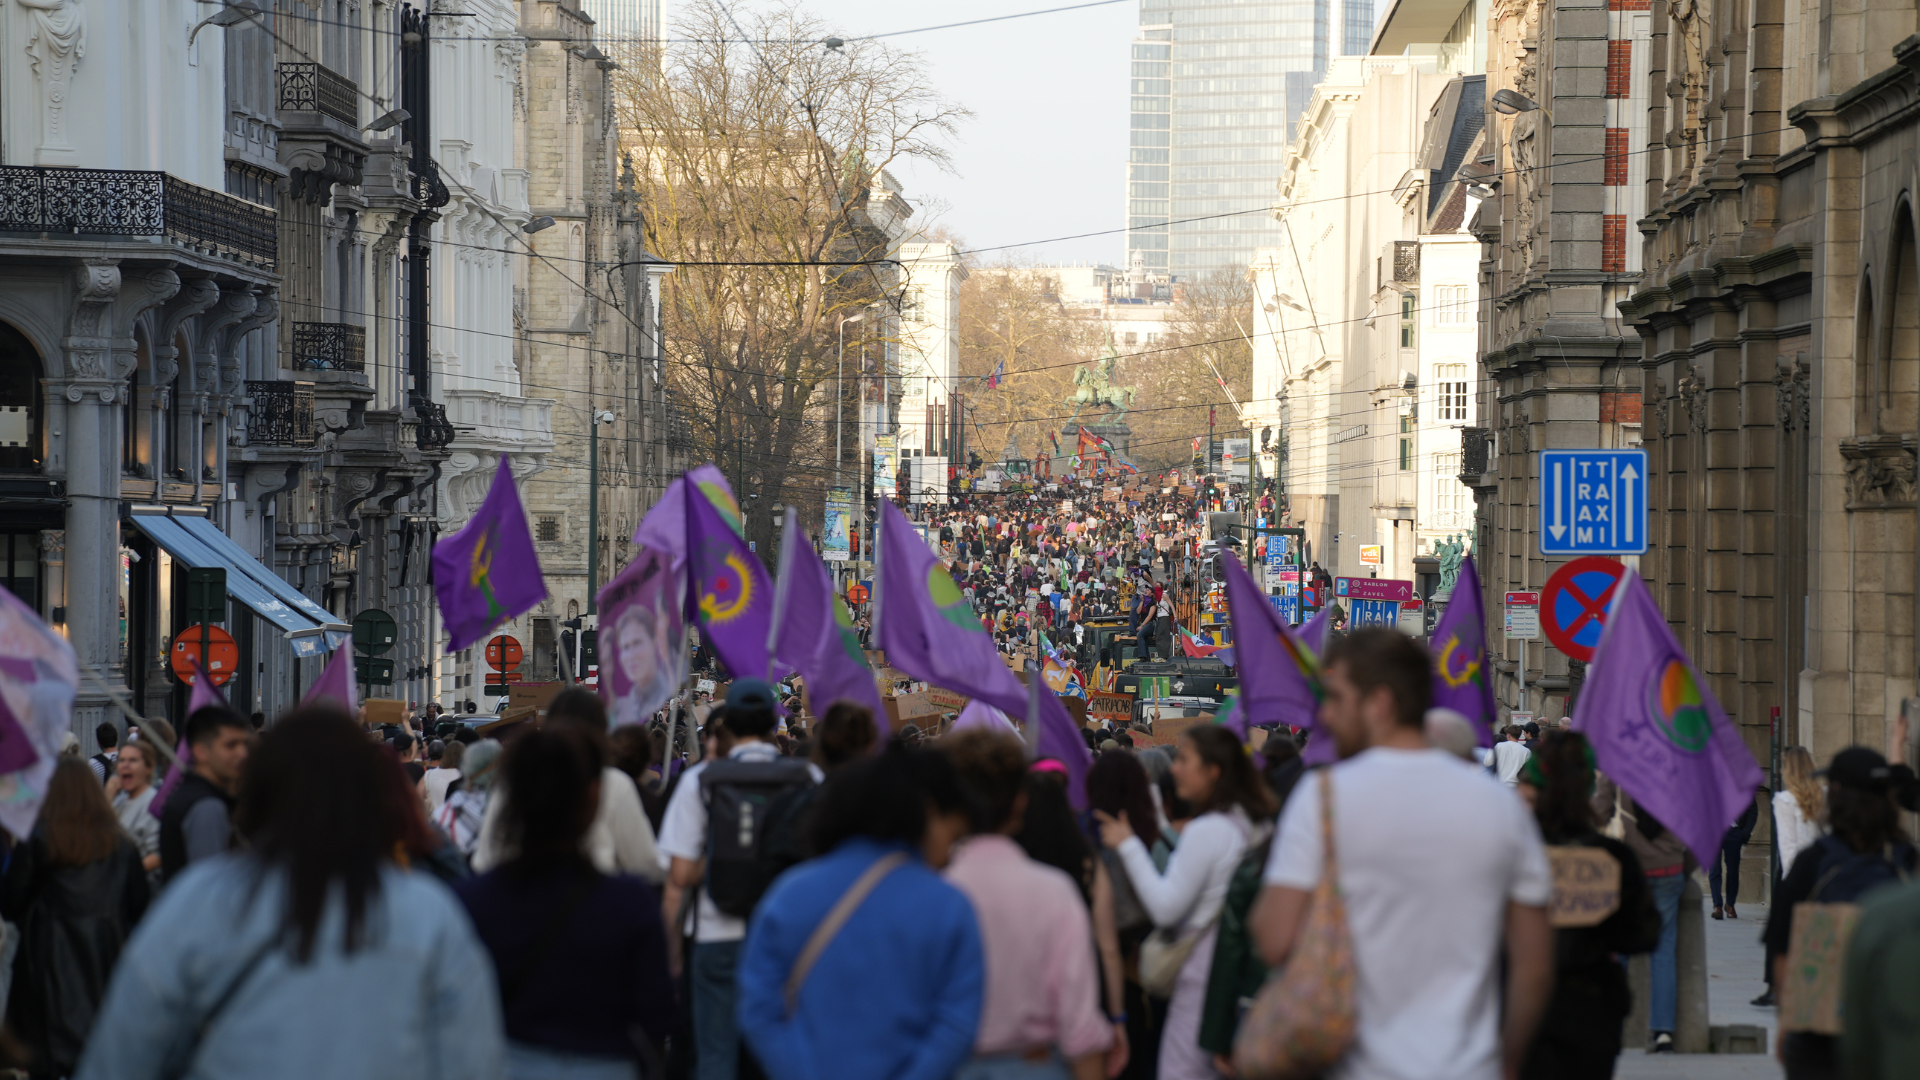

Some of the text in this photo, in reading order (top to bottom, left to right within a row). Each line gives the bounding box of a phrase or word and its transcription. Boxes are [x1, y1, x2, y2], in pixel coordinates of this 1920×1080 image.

[1258, 518, 1264, 526] P
[1274, 556, 1281, 565] P
[1337, 580, 1348, 593] P
[1092, 697, 1130, 714] PATRIACAB
